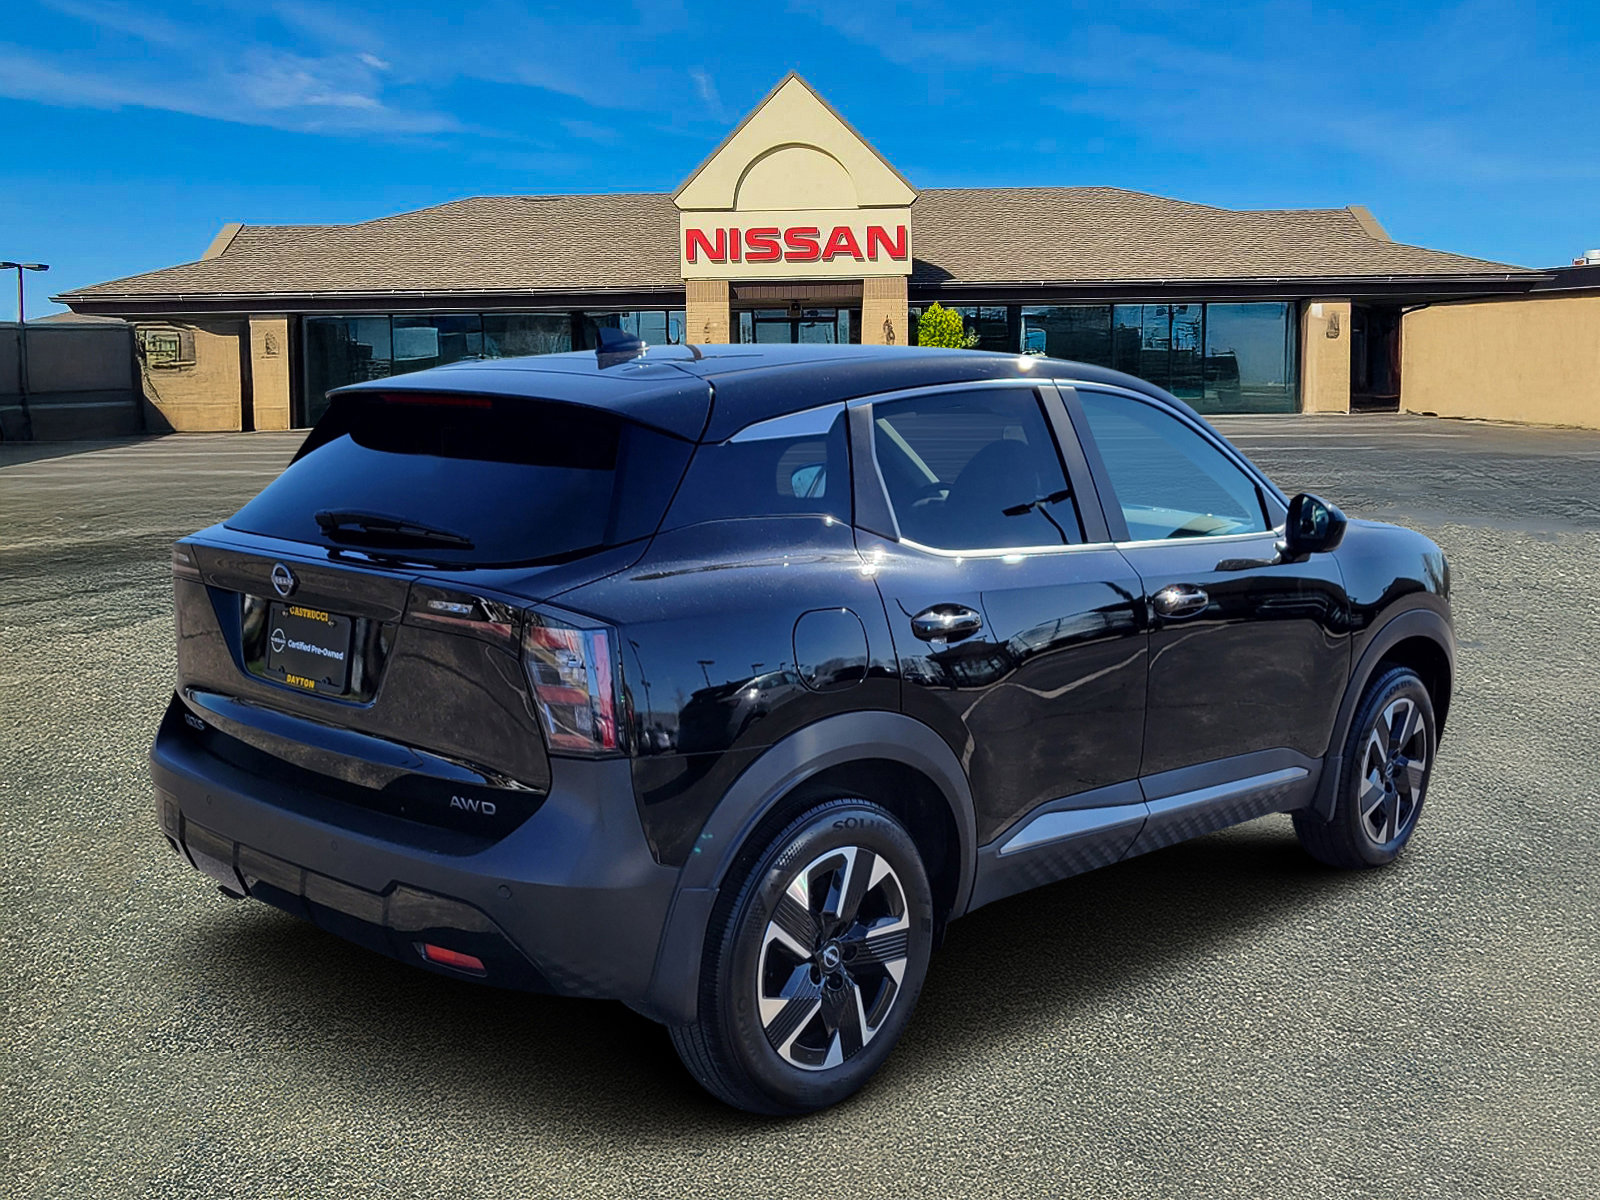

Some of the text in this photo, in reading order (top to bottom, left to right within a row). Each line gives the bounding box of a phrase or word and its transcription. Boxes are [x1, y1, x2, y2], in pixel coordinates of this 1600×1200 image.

[685, 225, 908, 263] NISSAN
[290, 606, 329, 621] CASTRUCCI
[288, 640, 344, 660] Certified Pre-Owned
[286, 674, 315, 688] DAYTON
[450, 795, 496, 815] AWD
